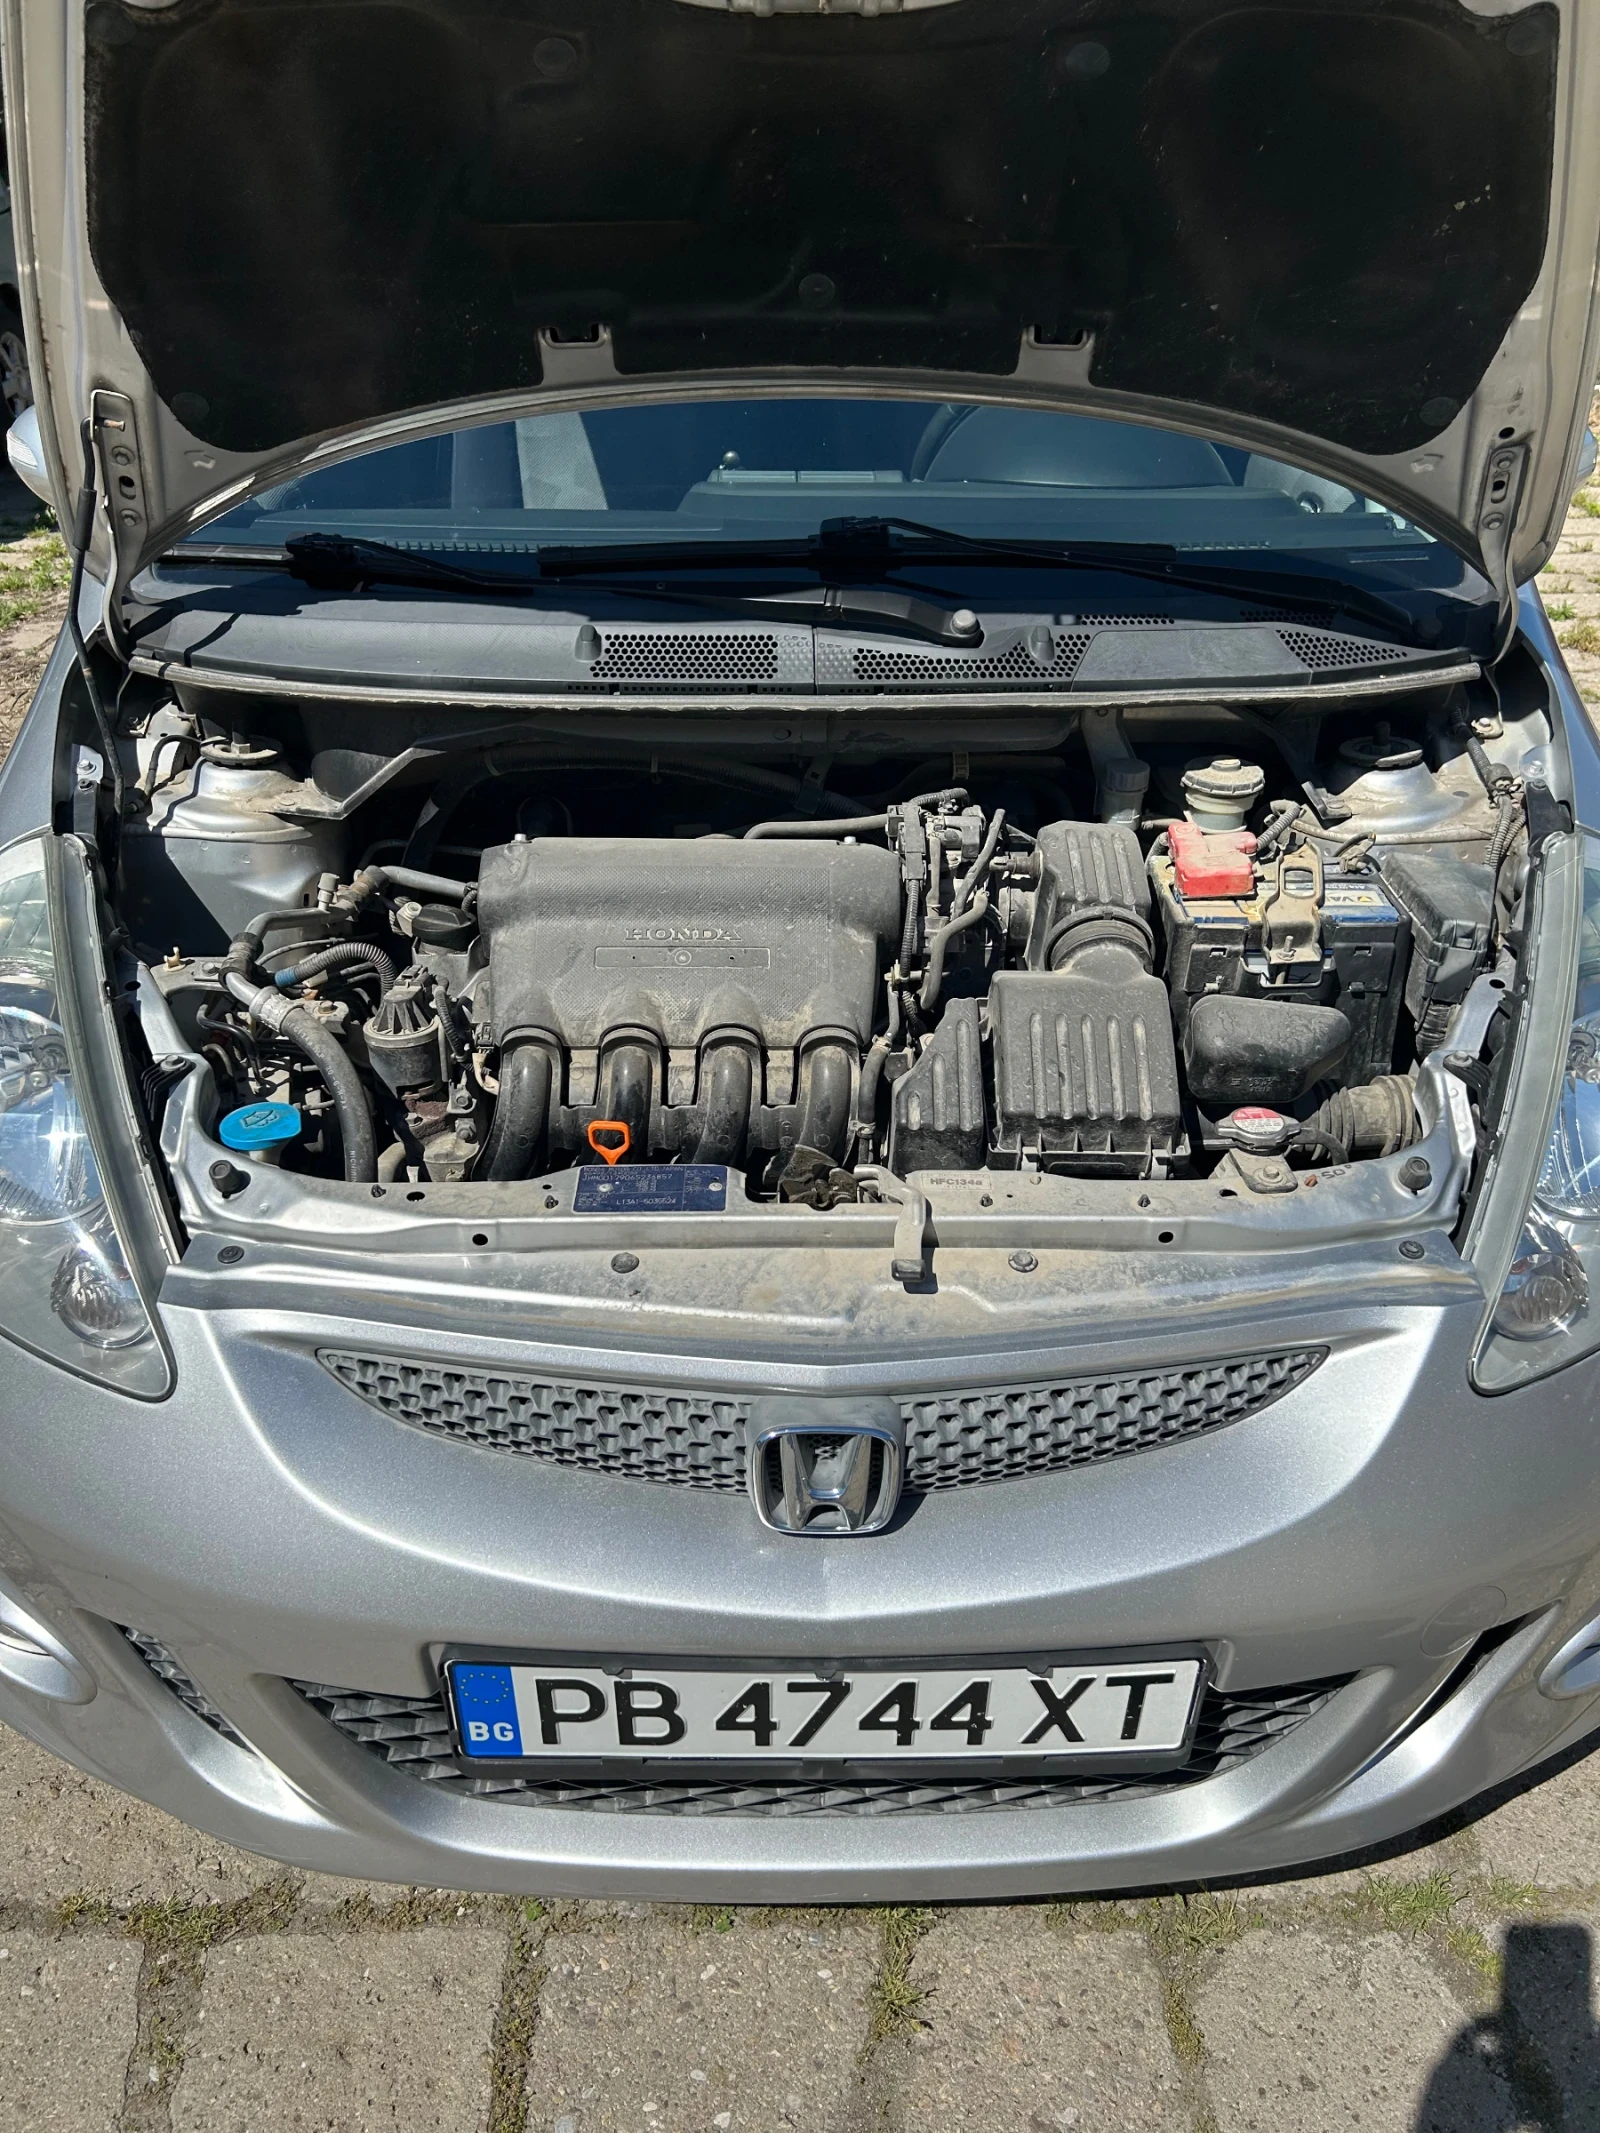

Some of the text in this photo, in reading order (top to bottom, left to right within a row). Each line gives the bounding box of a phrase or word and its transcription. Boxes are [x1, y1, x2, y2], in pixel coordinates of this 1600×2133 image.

[625, 927, 742, 941] HONDA
[930, 1178, 983, 1186] HFC134a
[535, 1673, 1177, 1747] PB 4744 XT
[470, 1721, 514, 1742] BG
